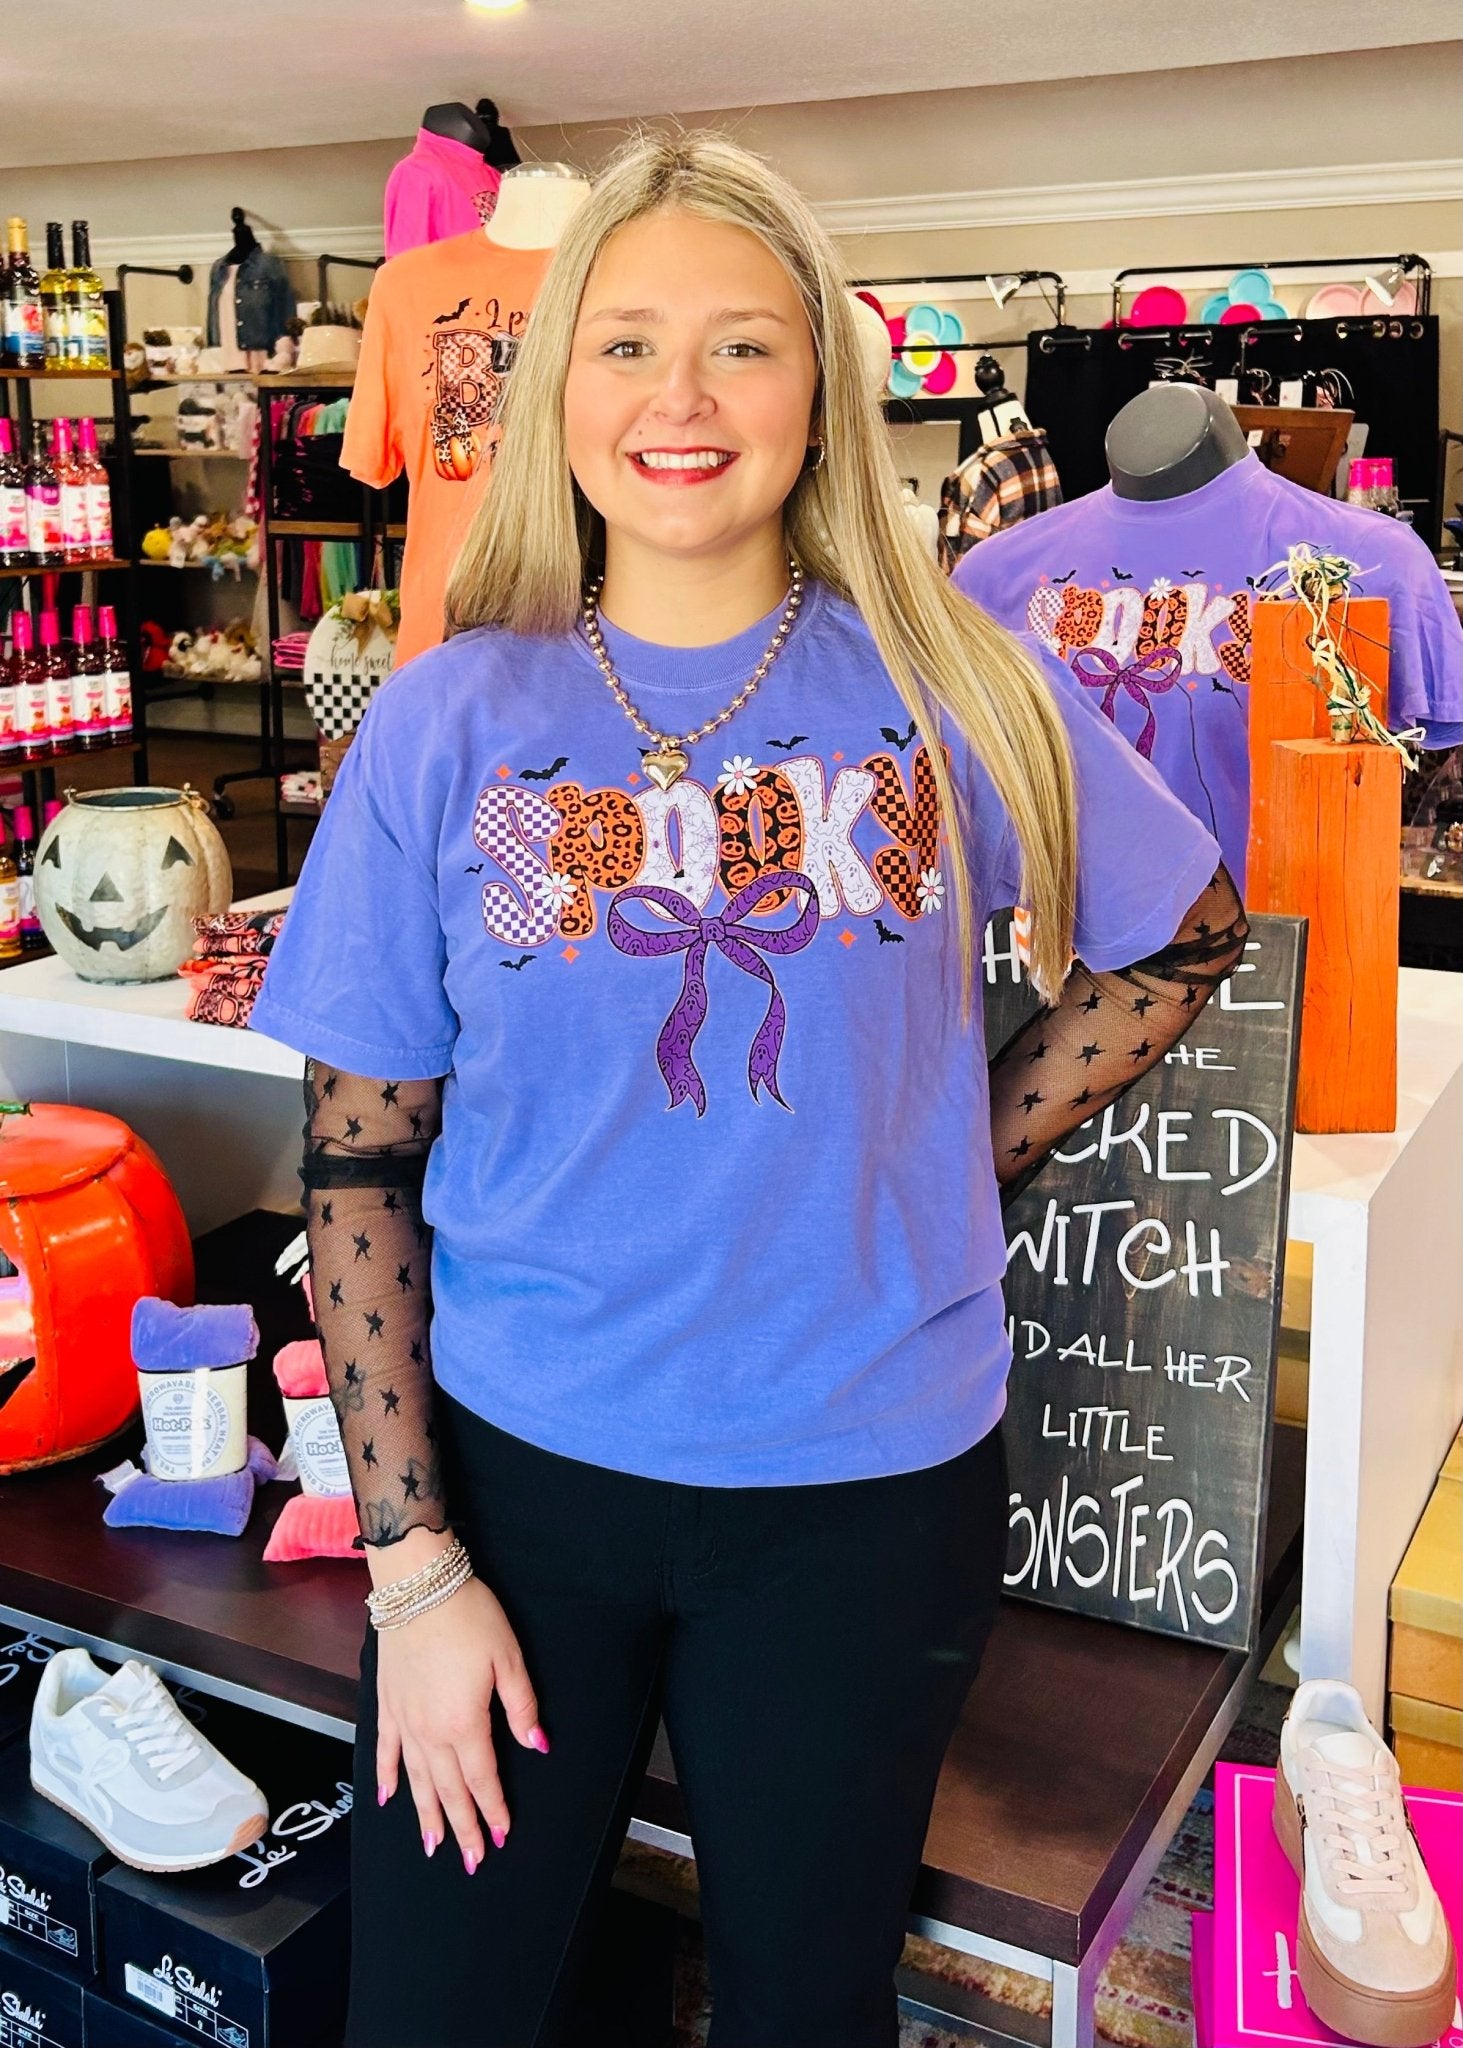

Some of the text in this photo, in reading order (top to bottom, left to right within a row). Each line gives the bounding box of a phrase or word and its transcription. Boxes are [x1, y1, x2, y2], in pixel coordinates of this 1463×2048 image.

[473, 745, 948, 947] SPOOKY
[1163, 1043, 1238, 1071] HE
[1050, 1102, 1278, 1196] CKED
[1057, 1333, 1152, 1373] ALL
[1163, 1345, 1252, 1402] HER
[294, 1402, 335, 1437] MICROWAV
[1042, 1403, 1174, 1461] LITTLE
[1003, 1474, 1239, 1632] ONSTERS
